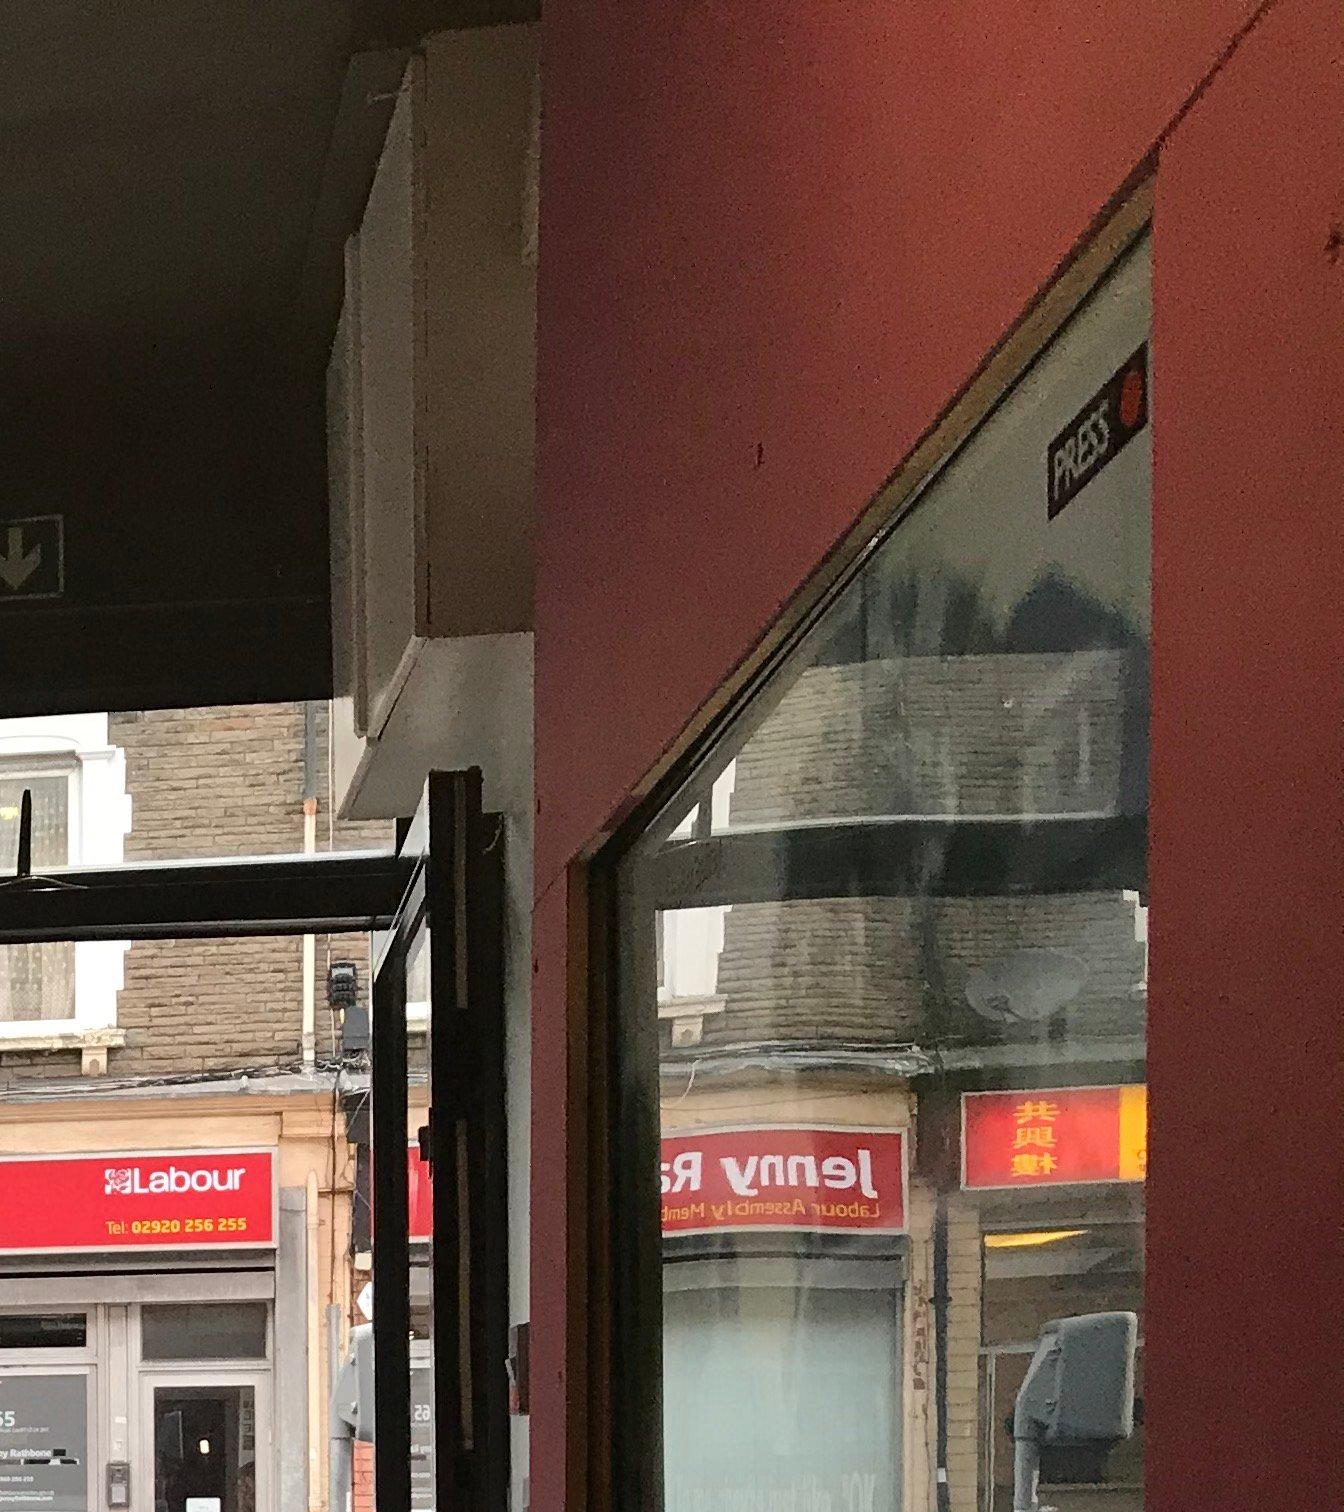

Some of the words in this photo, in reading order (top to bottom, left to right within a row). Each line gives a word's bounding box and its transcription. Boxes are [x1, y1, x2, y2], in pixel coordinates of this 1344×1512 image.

[1053, 397, 1111, 499] PRESS
[133, 1166, 247, 1194] Labour
[131, 1219, 181, 1235] 02920
[184, 1218, 214, 1233] 256
[217, 1217, 247, 1232] 255
[9, 1448, 52, 1458] Rathbone
